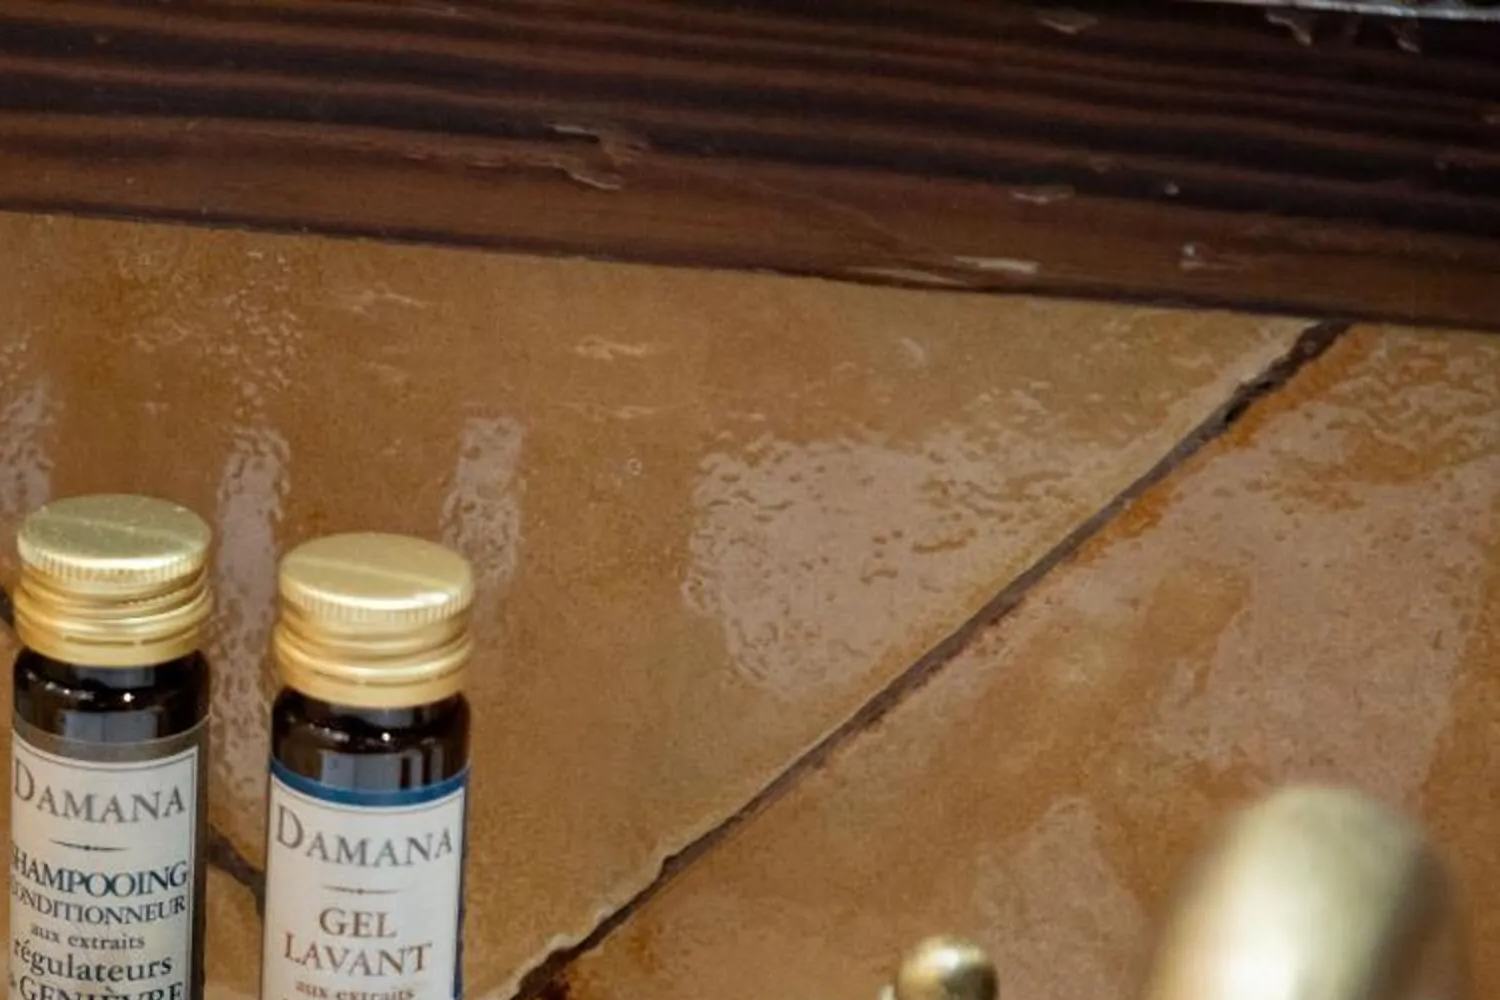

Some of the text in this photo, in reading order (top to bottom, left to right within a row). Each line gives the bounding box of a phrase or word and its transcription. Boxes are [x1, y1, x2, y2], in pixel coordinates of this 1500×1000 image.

[14, 757, 186, 823] DAMANA
[276, 803, 452, 868] DAMANA
[11, 845, 188, 897] HAMPOOING
[11, 877, 186, 926] ONDITIONNEUR
[319, 907, 397, 938] GEL
[13, 938, 173, 983] régulateurs
[31, 924, 145, 952] aux extraits
[284, 932, 432, 977] LAVANT
[295, 980, 328, 998] aux
